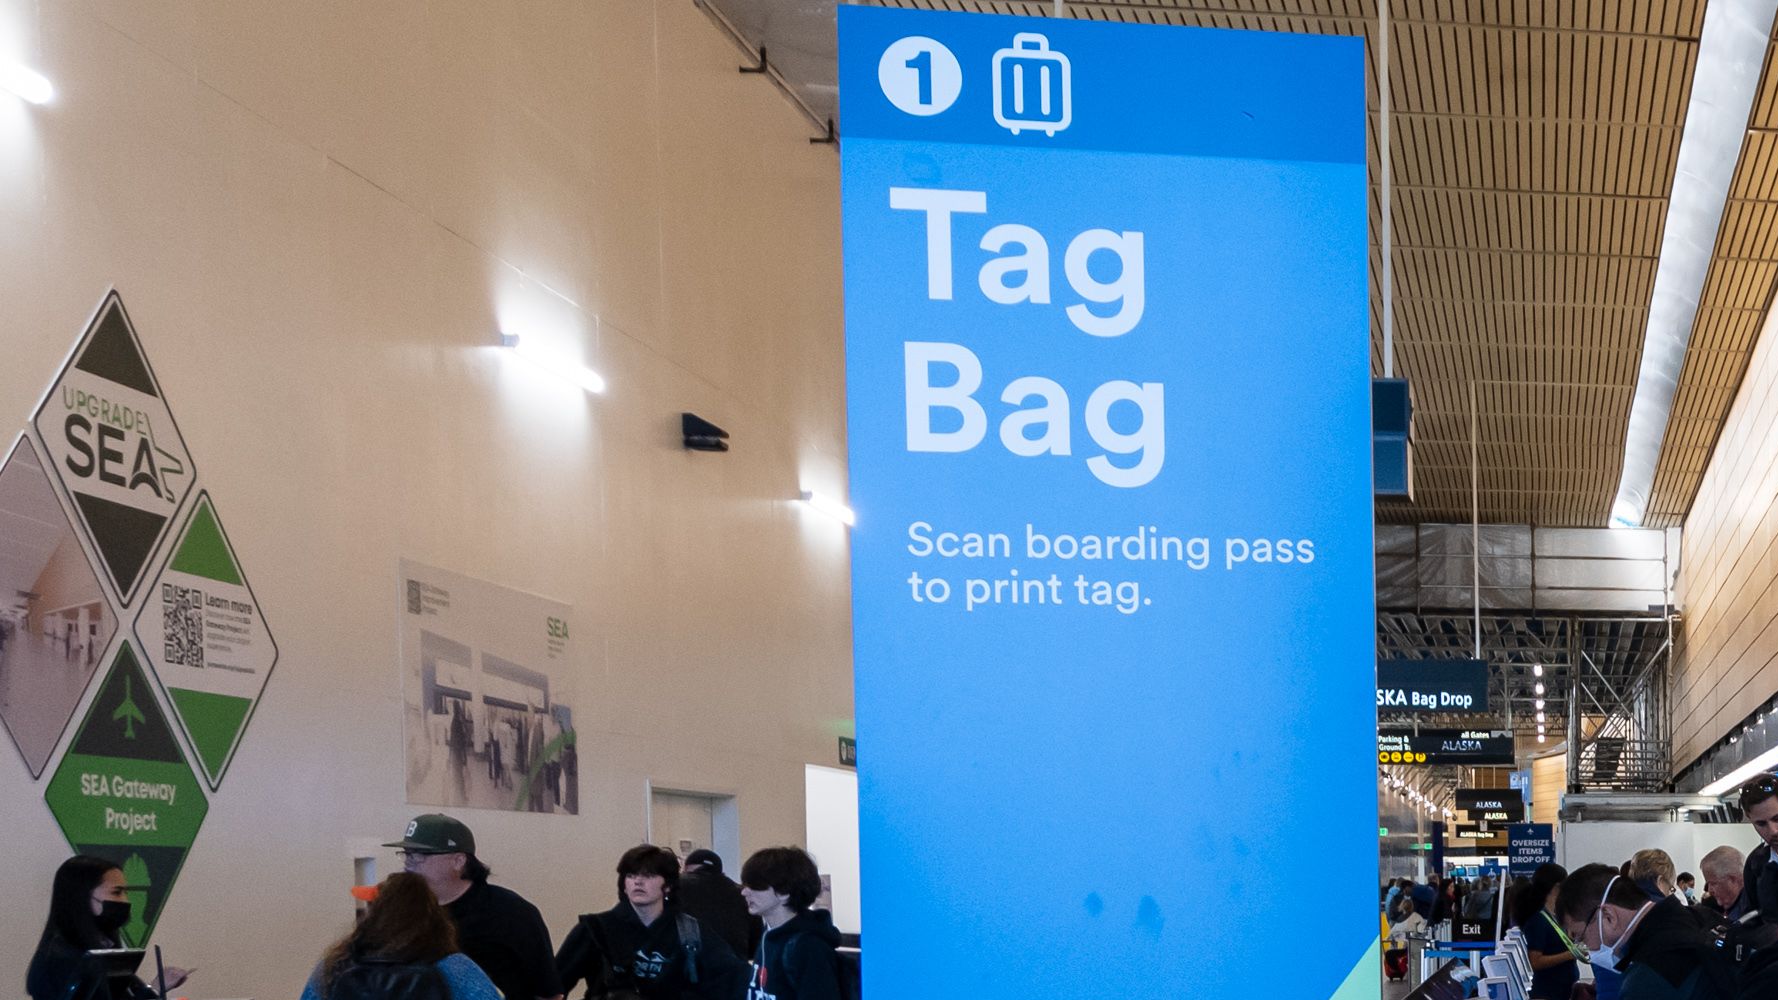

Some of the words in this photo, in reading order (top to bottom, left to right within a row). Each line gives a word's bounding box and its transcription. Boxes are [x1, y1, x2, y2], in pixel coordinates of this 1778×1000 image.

[905, 50, 932, 106] 1
[889, 186, 1145, 337] Tag
[63, 385, 147, 436] UPGRADE
[904, 341, 1166, 488] Bag
[64, 413, 163, 498] SEA
[907, 521, 1011, 559] Scan
[1026, 524, 1210, 570] boarding
[1225, 534, 1316, 571] pass
[205, 592, 230, 610] Learn
[231, 600, 253, 615] more
[907, 571, 951, 604] to
[966, 569, 1064, 611] print
[1074, 574, 1152, 615] tag.
[547, 616, 569, 640] SEA
[1376, 688, 1408, 706] SKA
[1412, 691, 1437, 709] Bag
[1440, 691, 1473, 709] Drop
[1378, 735, 1402, 745] Parking
[1378, 743, 1402, 751] Ground
[1441, 740, 1482, 751] ALASKA
[81, 773, 110, 796] SEA
[112, 775, 176, 806] Gateway
[105, 807, 158, 836] Project
[405, 821, 418, 837] B
[1462, 924, 1481, 934] Exit
